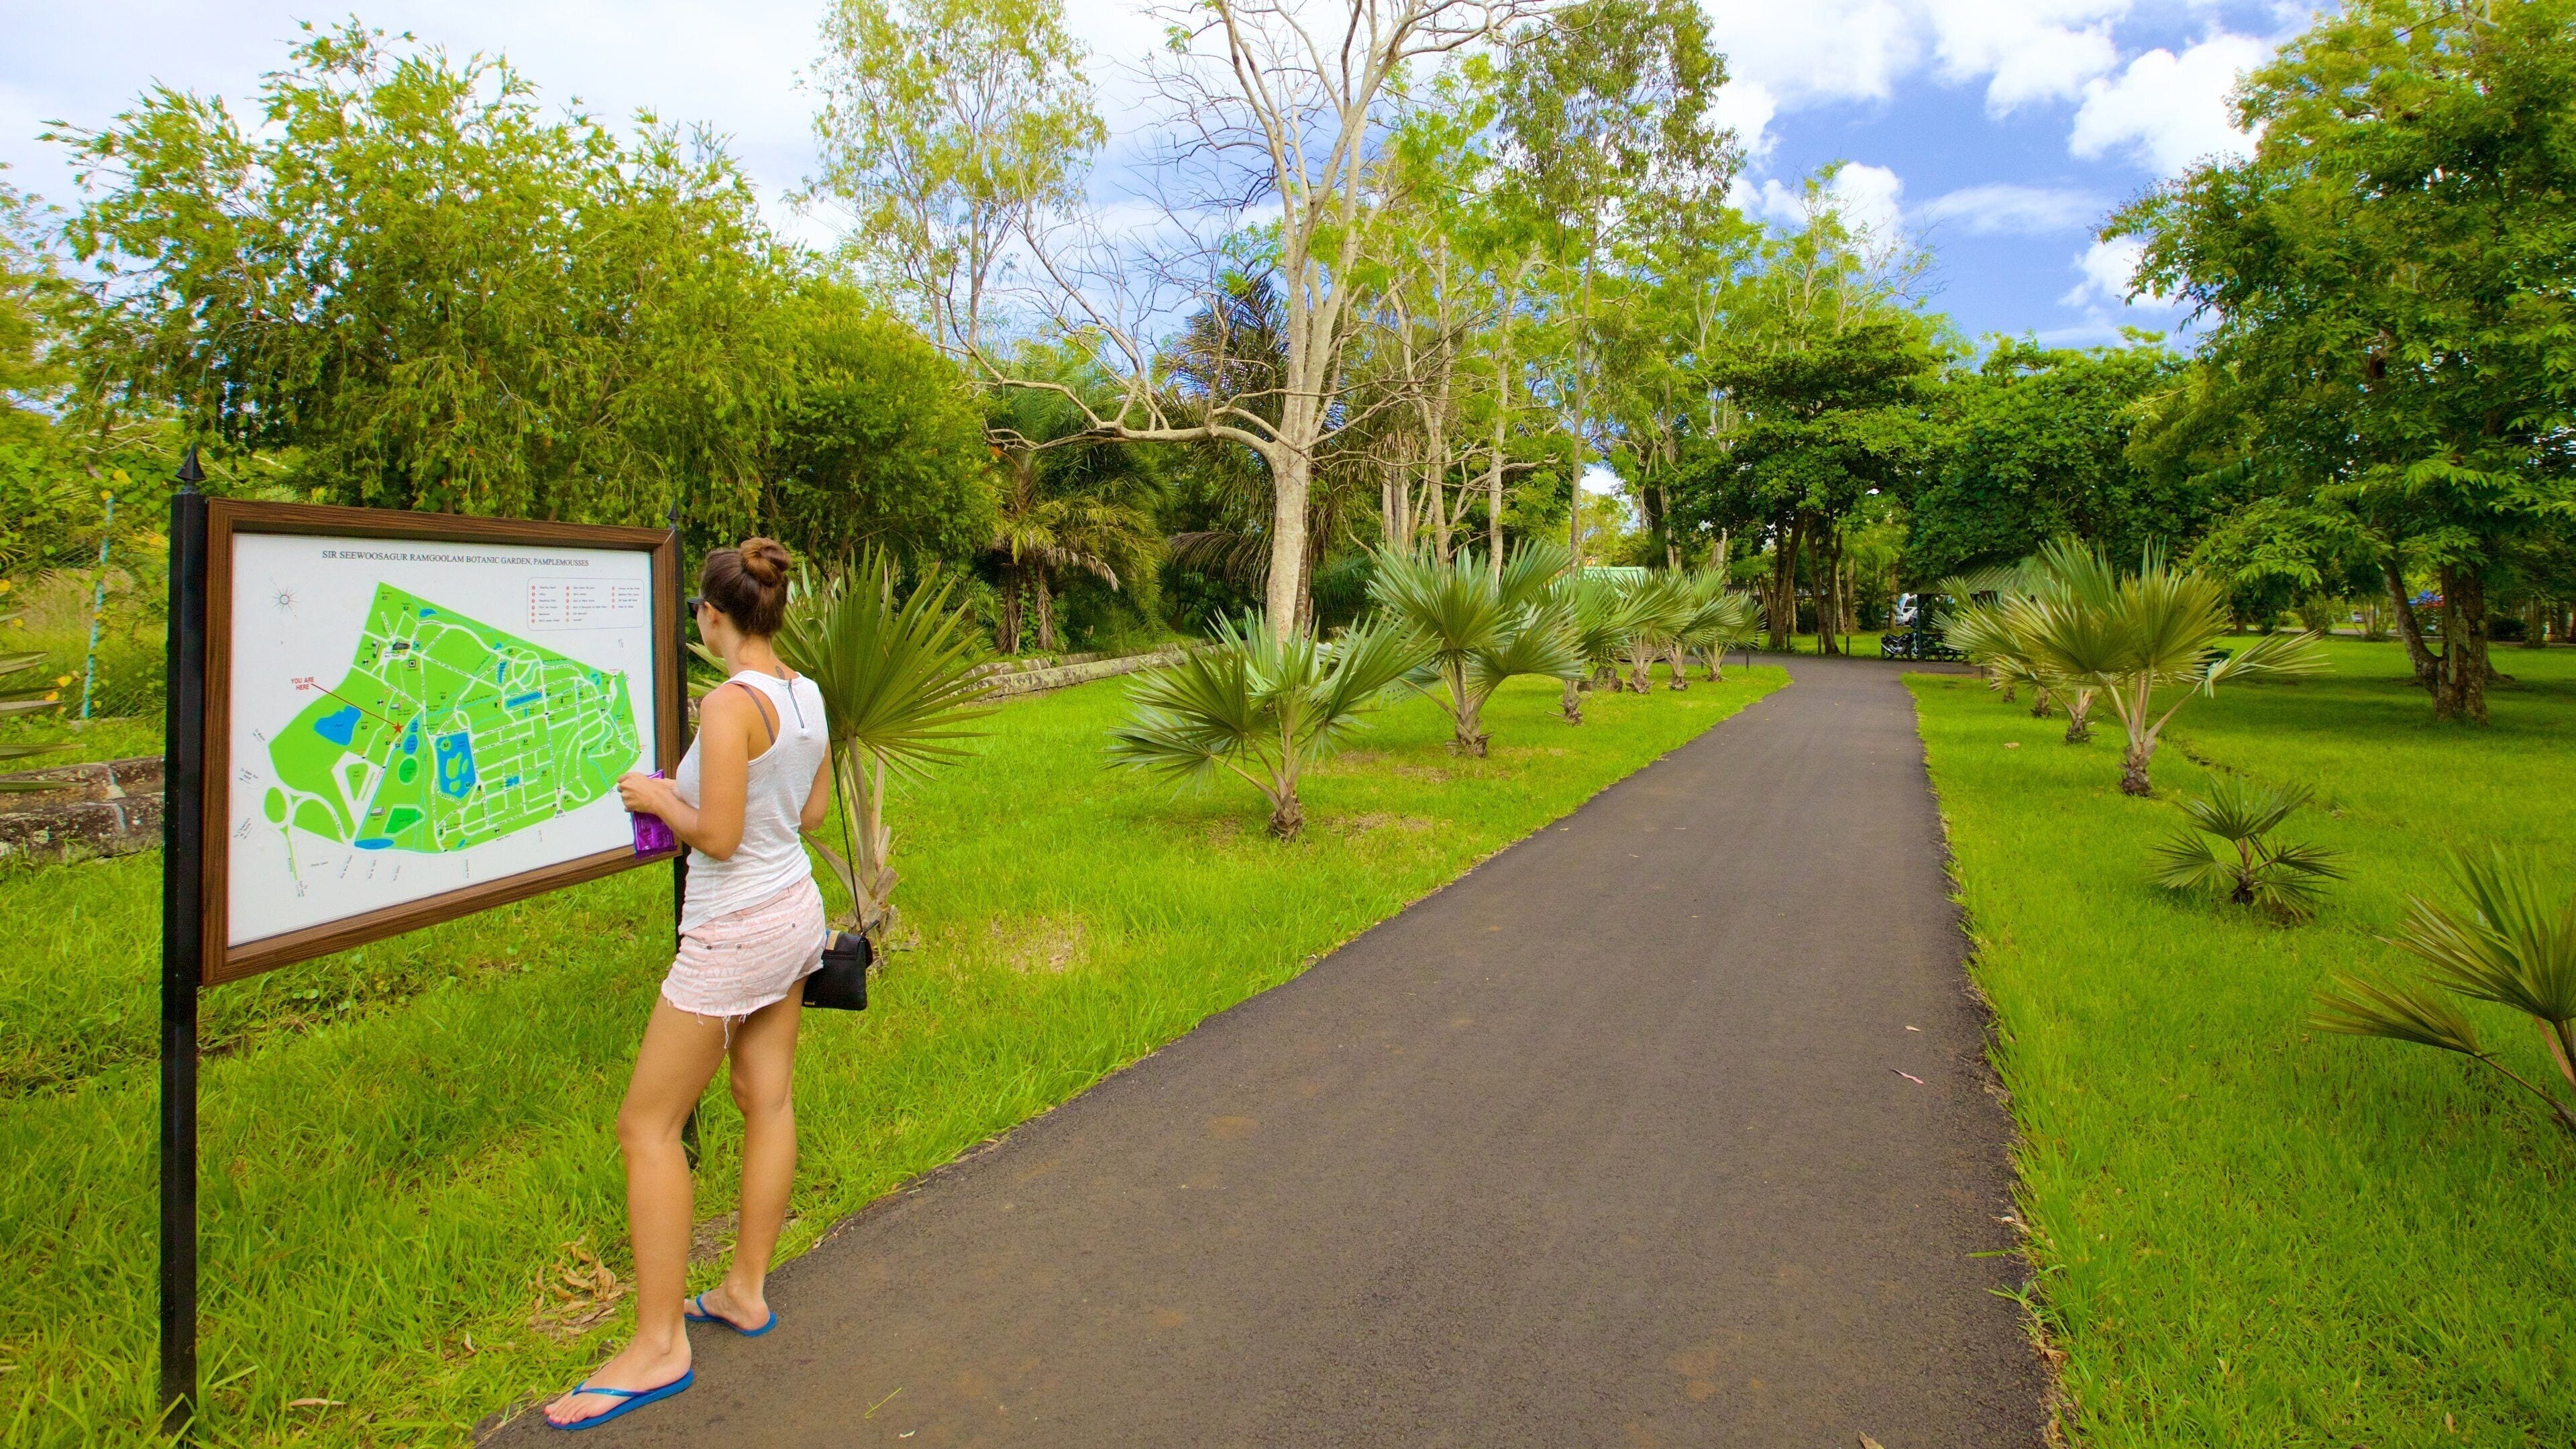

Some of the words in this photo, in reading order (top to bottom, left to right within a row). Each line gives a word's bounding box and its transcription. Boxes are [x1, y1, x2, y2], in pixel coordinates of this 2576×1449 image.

[322, 550, 337, 559] SIR
[339, 551, 409, 561] SEEWOOSAGUR
[410, 553, 464, 563] RAMGOOLAM
[466, 555, 500, 564] BOTANIC
[500, 557, 532, 566] GARDEN,
[533, 557, 590, 567] PAMPLEMOUSSES
